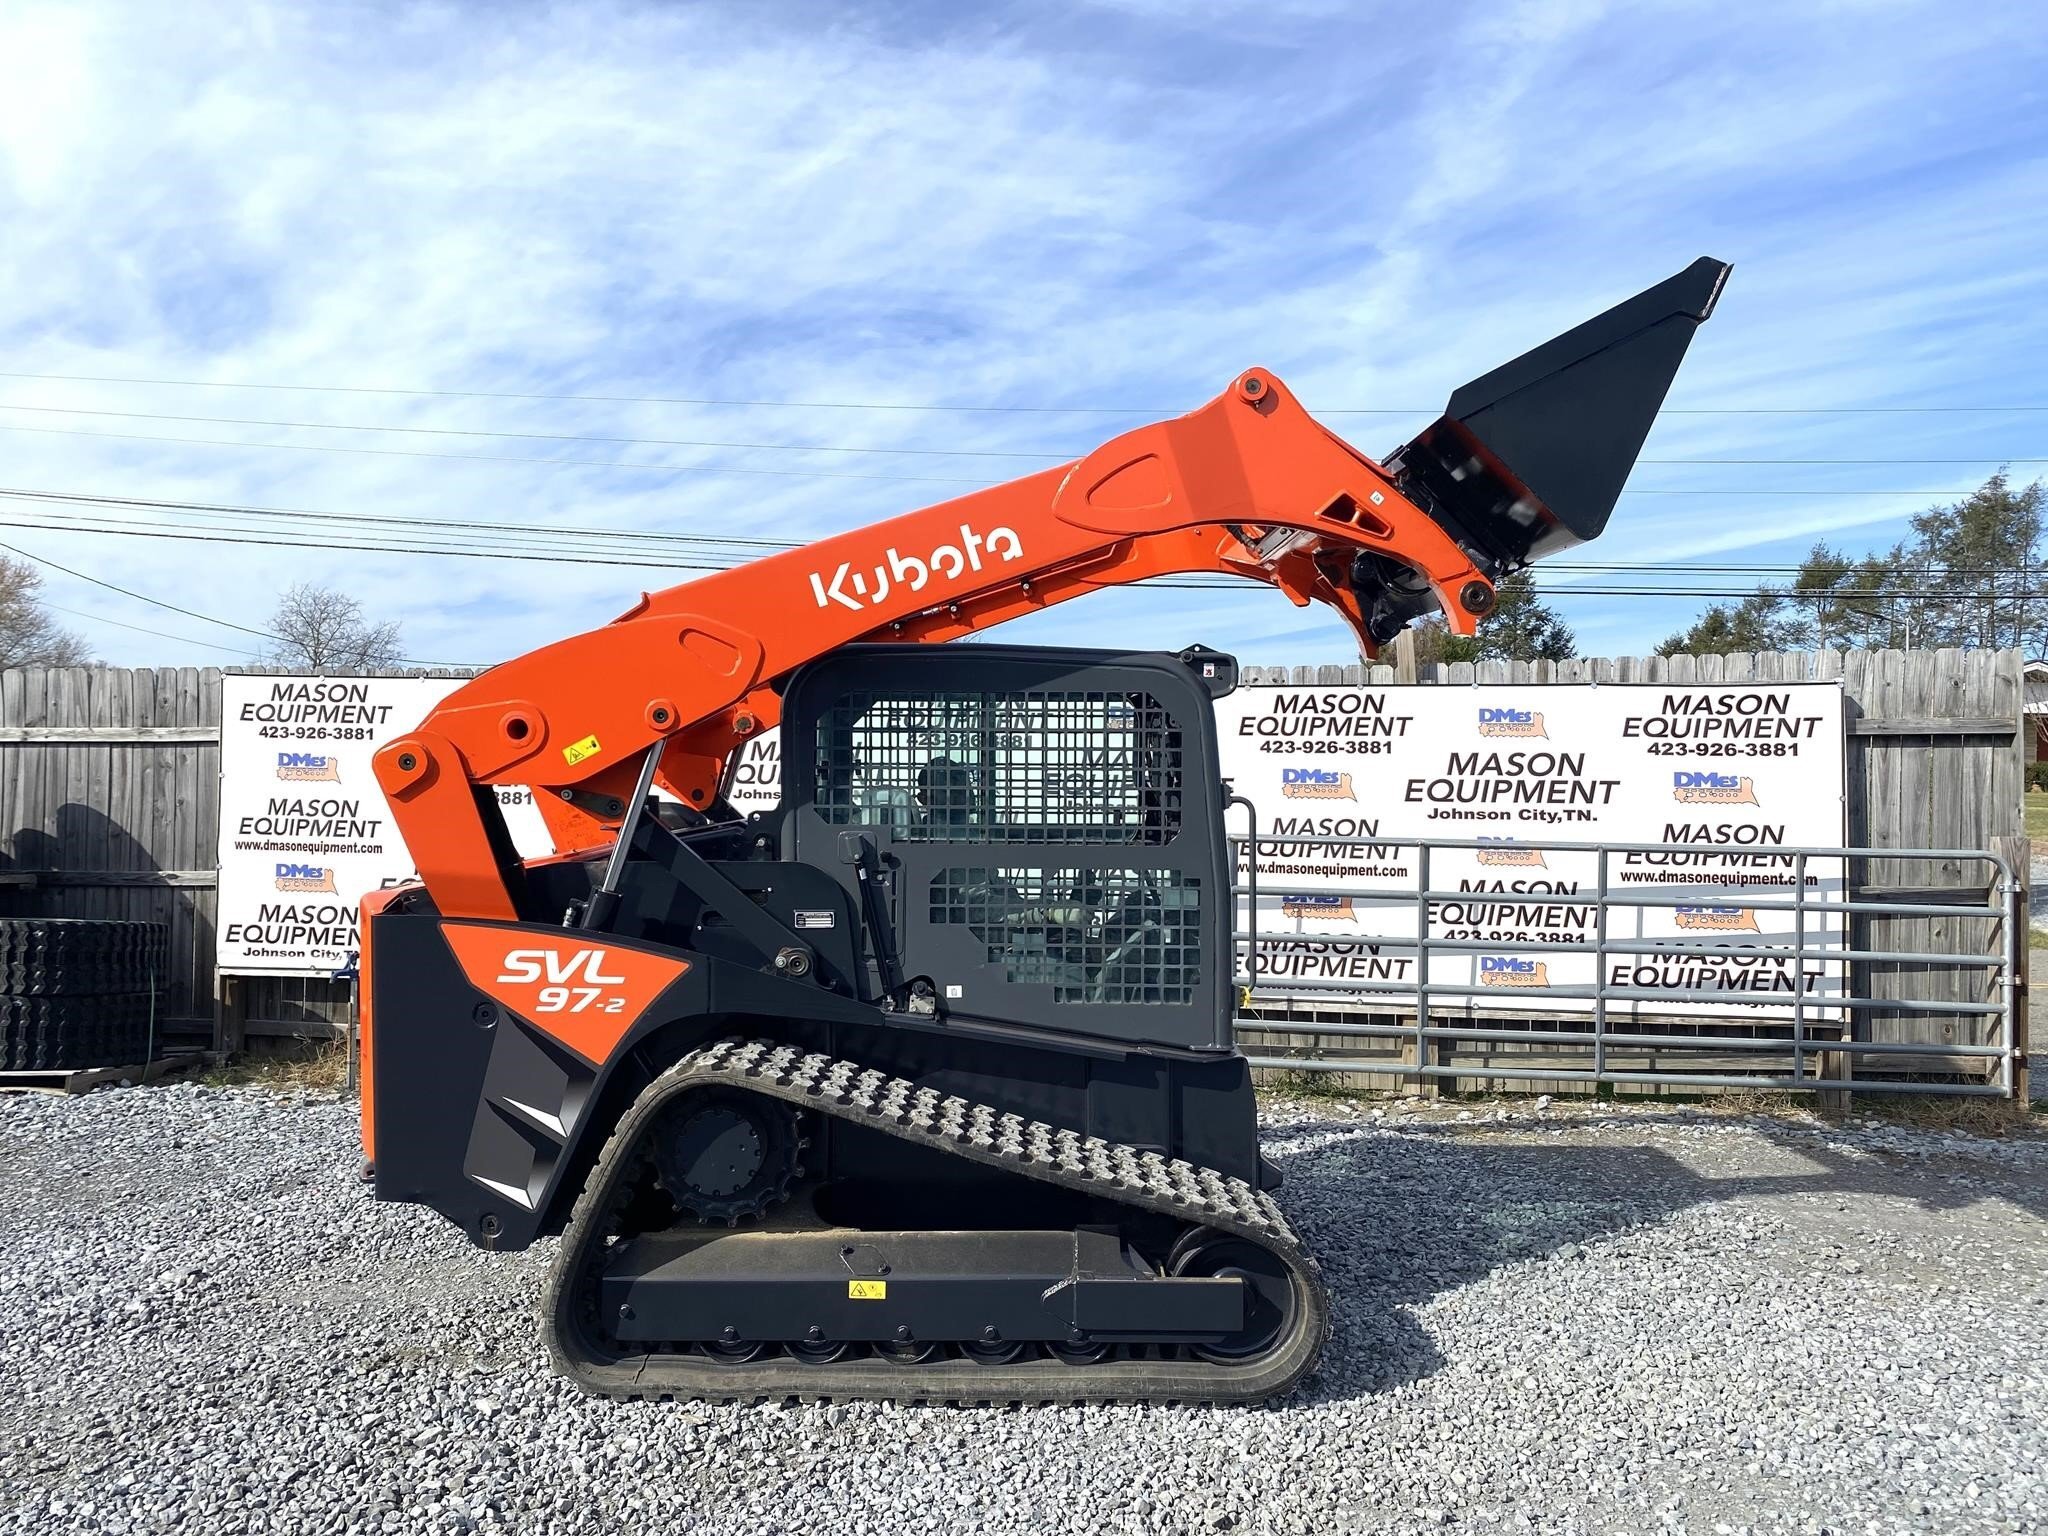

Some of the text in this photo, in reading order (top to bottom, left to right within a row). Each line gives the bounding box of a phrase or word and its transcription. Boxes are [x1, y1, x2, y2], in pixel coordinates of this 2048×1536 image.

[808, 523, 1025, 611] Kubota
[271, 684, 368, 703] MASON
[1273, 694, 1386, 714] MASON
[240, 703, 393, 724] EQUIPMENT
[1661, 694, 1790, 715] MASON
[259, 726, 374, 740] 423-926-3881
[1239, 716, 1414, 737] EQUIPMENT
[1622, 717, 1824, 738] EQUIPMENT
[1260, 740, 1392, 754] 423-926-3881
[1647, 742, 1799, 756] 423-926-3881
[1447, 752, 1585, 777] MASON
[1404, 778, 1621, 804] EQUIPMENT
[268, 798, 359, 817] MASON
[1427, 808, 1511, 820] Johnson
[239, 817, 382, 838] EQUIPMENT
[1272, 817, 1379, 837] MASON
[1663, 823, 1785, 845] MASON
[235, 839, 382, 855] www.dmasonequipment.com
[1240, 842, 1400, 860] EQUIPMENT
[1625, 851, 1808, 868] EQUIPMEN
[1459, 879, 1578, 895] MASON
[1620, 870, 1818, 887] www.dmasonequipment.cm
[258, 904, 359, 925] MASON
[1428, 902, 1607, 929] EQUIPMENT
[225, 924, 360, 946] EQUIPMEN
[1262, 931, 1382, 955] MASON
[1444, 929, 1586, 944] 423-926-3881
[243, 948, 305, 958] Johnson
[1652, 943, 1788, 968] MASON
[496, 950, 626, 984] SVL
[1236, 953, 1413, 980] EQUIPMENT
[1610, 965, 1824, 993] EQUIPMENT
[535, 987, 626, 1013] 97-2
